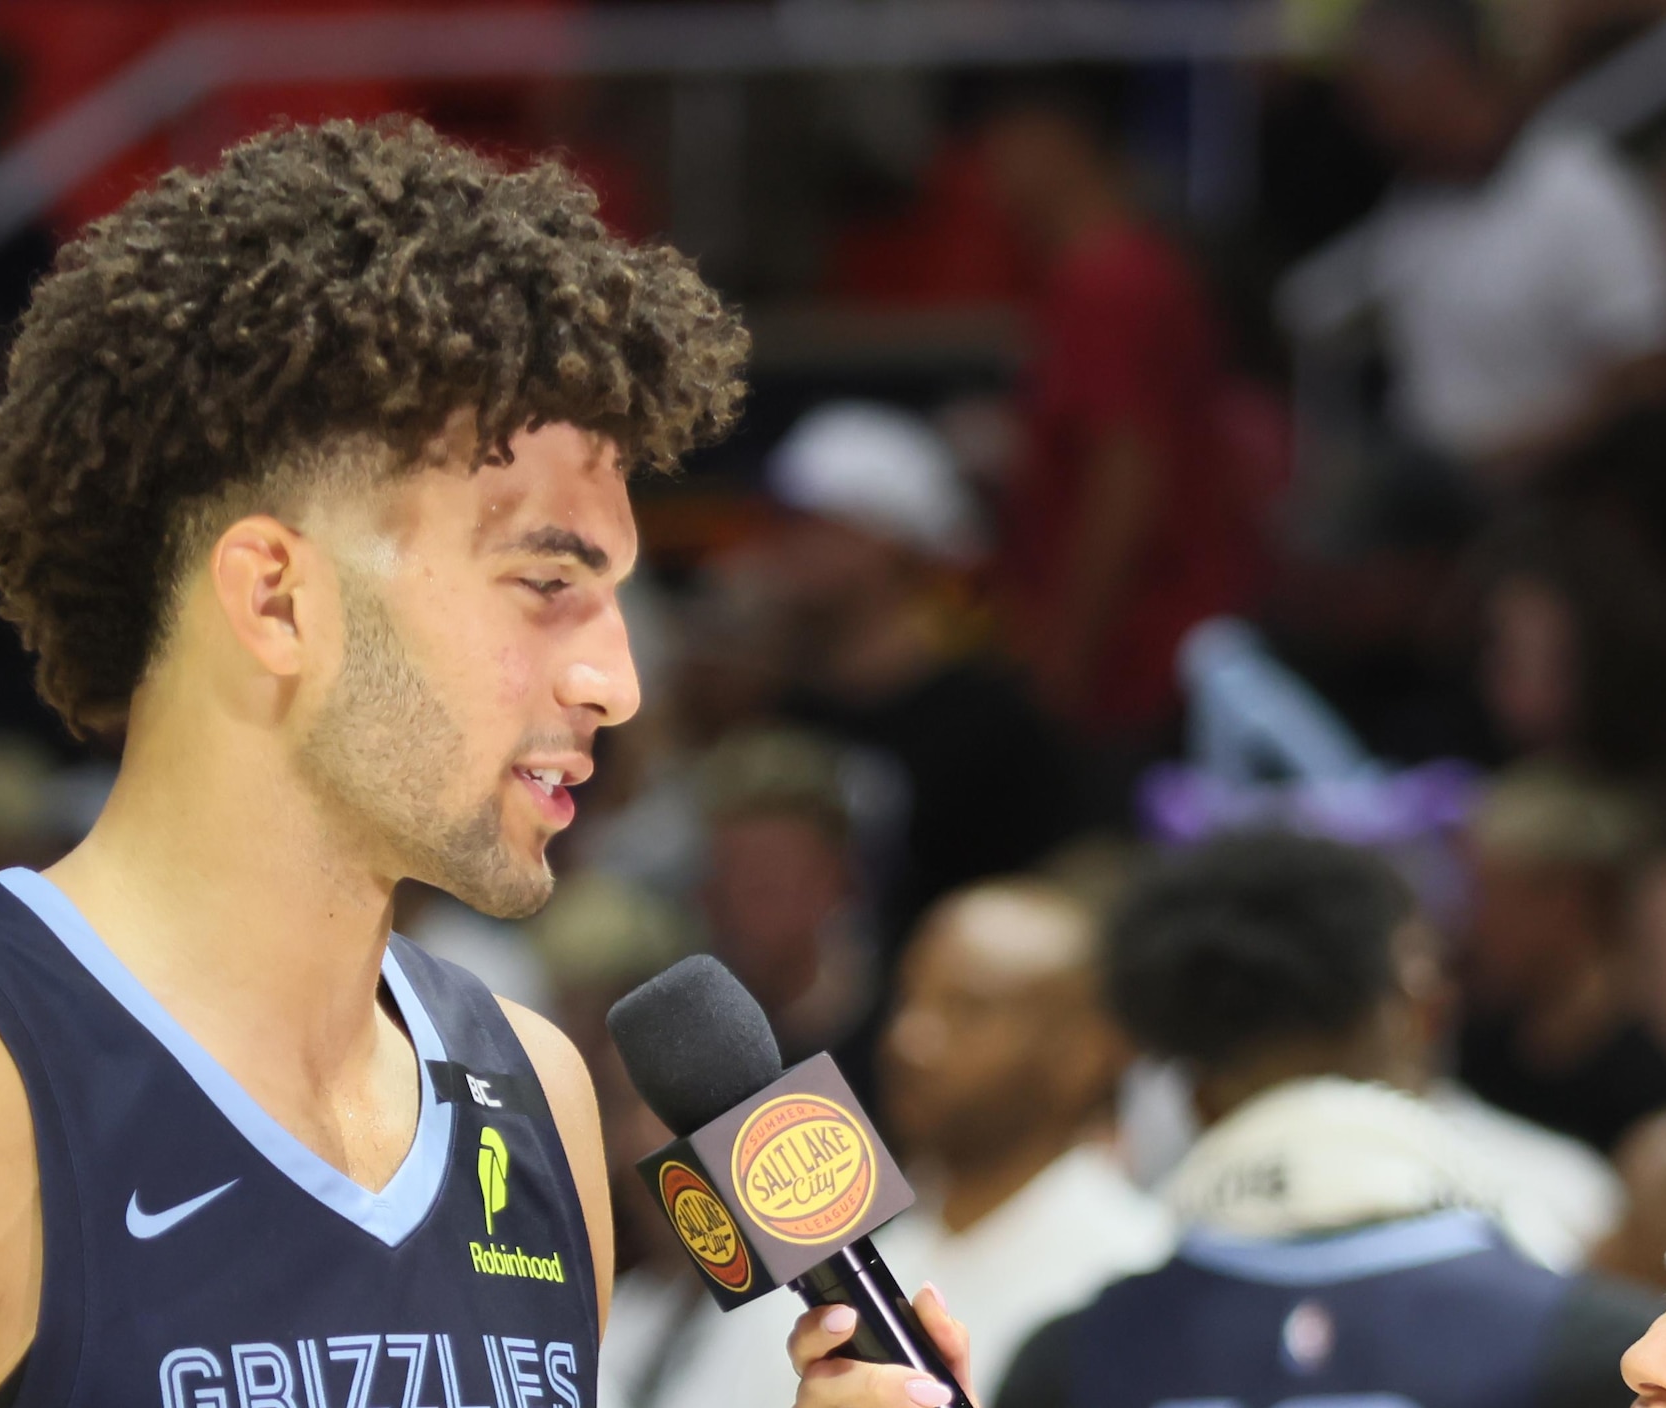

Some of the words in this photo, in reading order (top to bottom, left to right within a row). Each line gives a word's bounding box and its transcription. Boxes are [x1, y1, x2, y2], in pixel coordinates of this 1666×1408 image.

[749, 1106, 806, 1145] SUMMER
[752, 1139, 795, 1202] SALT
[791, 1126, 851, 1173] LAKE
[793, 1168, 836, 1204] City
[805, 1195, 857, 1232] LEAGUE
[469, 1242, 565, 1284] Robinhood
